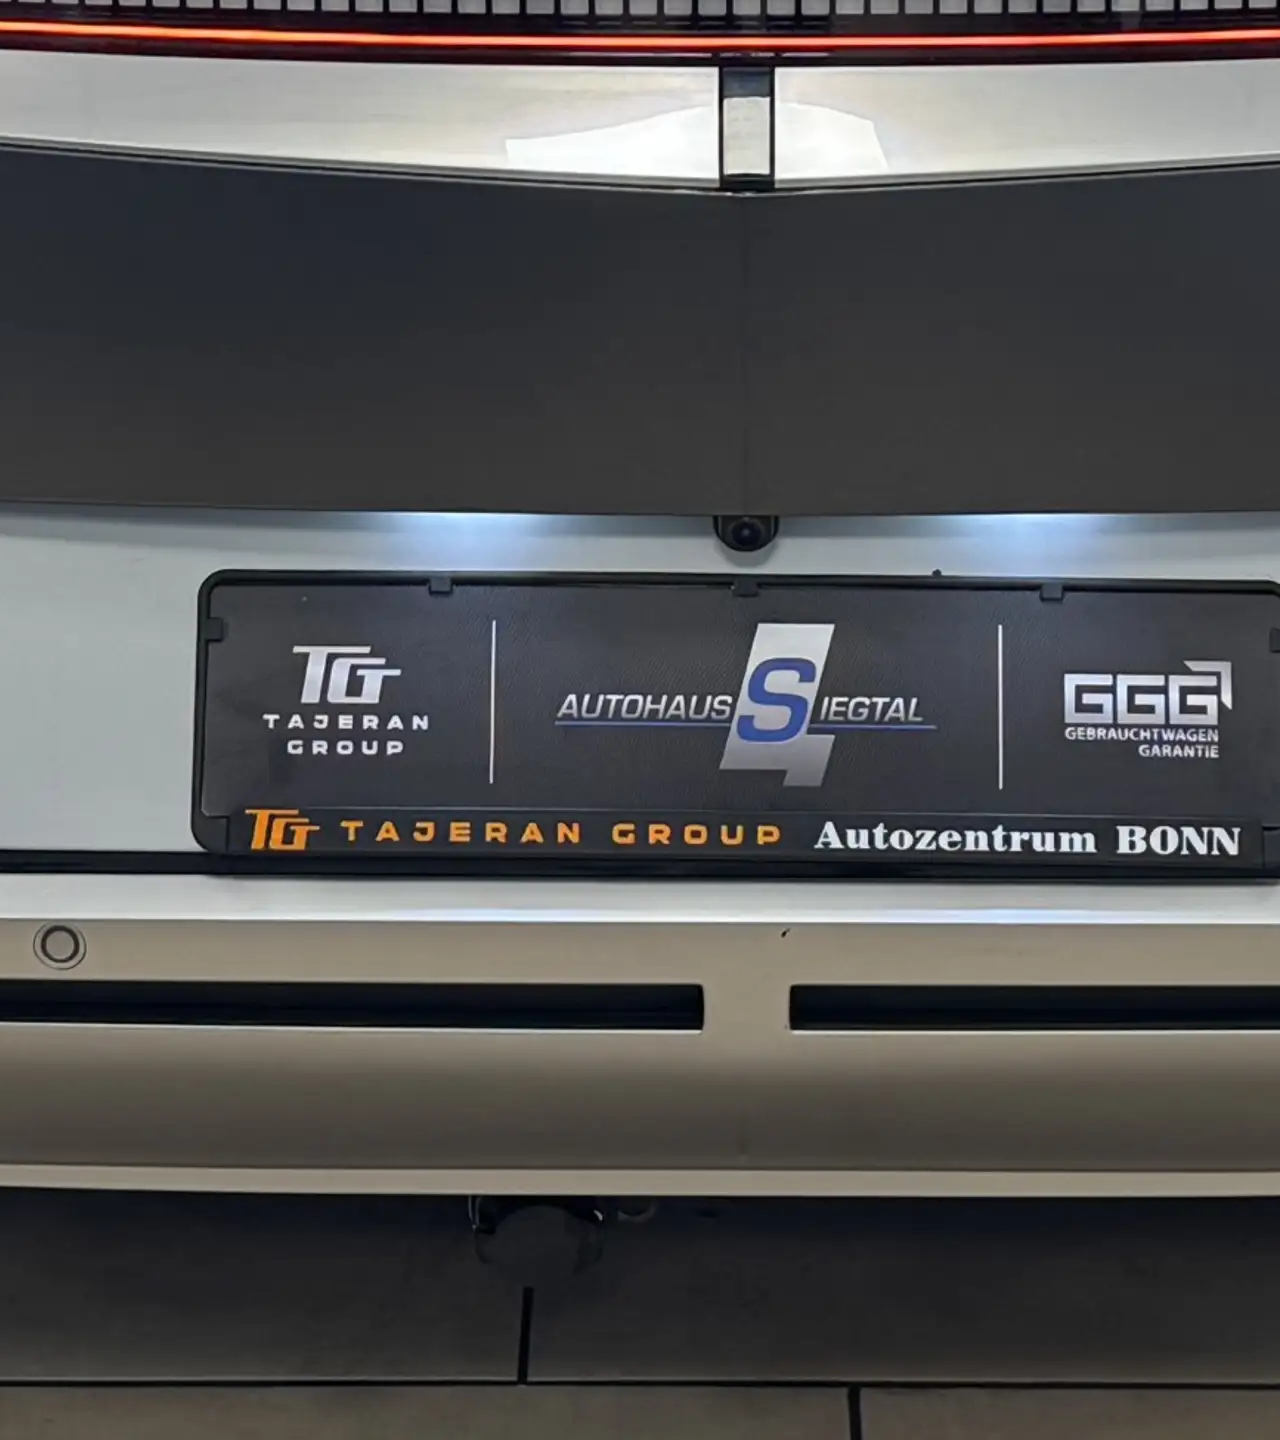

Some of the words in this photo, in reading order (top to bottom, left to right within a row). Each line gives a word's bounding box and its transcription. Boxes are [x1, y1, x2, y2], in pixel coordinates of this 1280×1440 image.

[556, 693, 732, 721] AUTOHAUS
[1064, 673, 1219, 726] GGG
[262, 714, 429, 730] TAJERAN
[1064, 727, 1219, 742] GEBRAUCHTWAGEN
[286, 740, 404, 755] GROUP
[1138, 744, 1220, 759] GARANTIE
[340, 820, 581, 844] TAJERAN
[611, 824, 781, 846] GROUP
[814, 820, 1098, 854] Autozentrum
[1116, 824, 1241, 856] BONN
